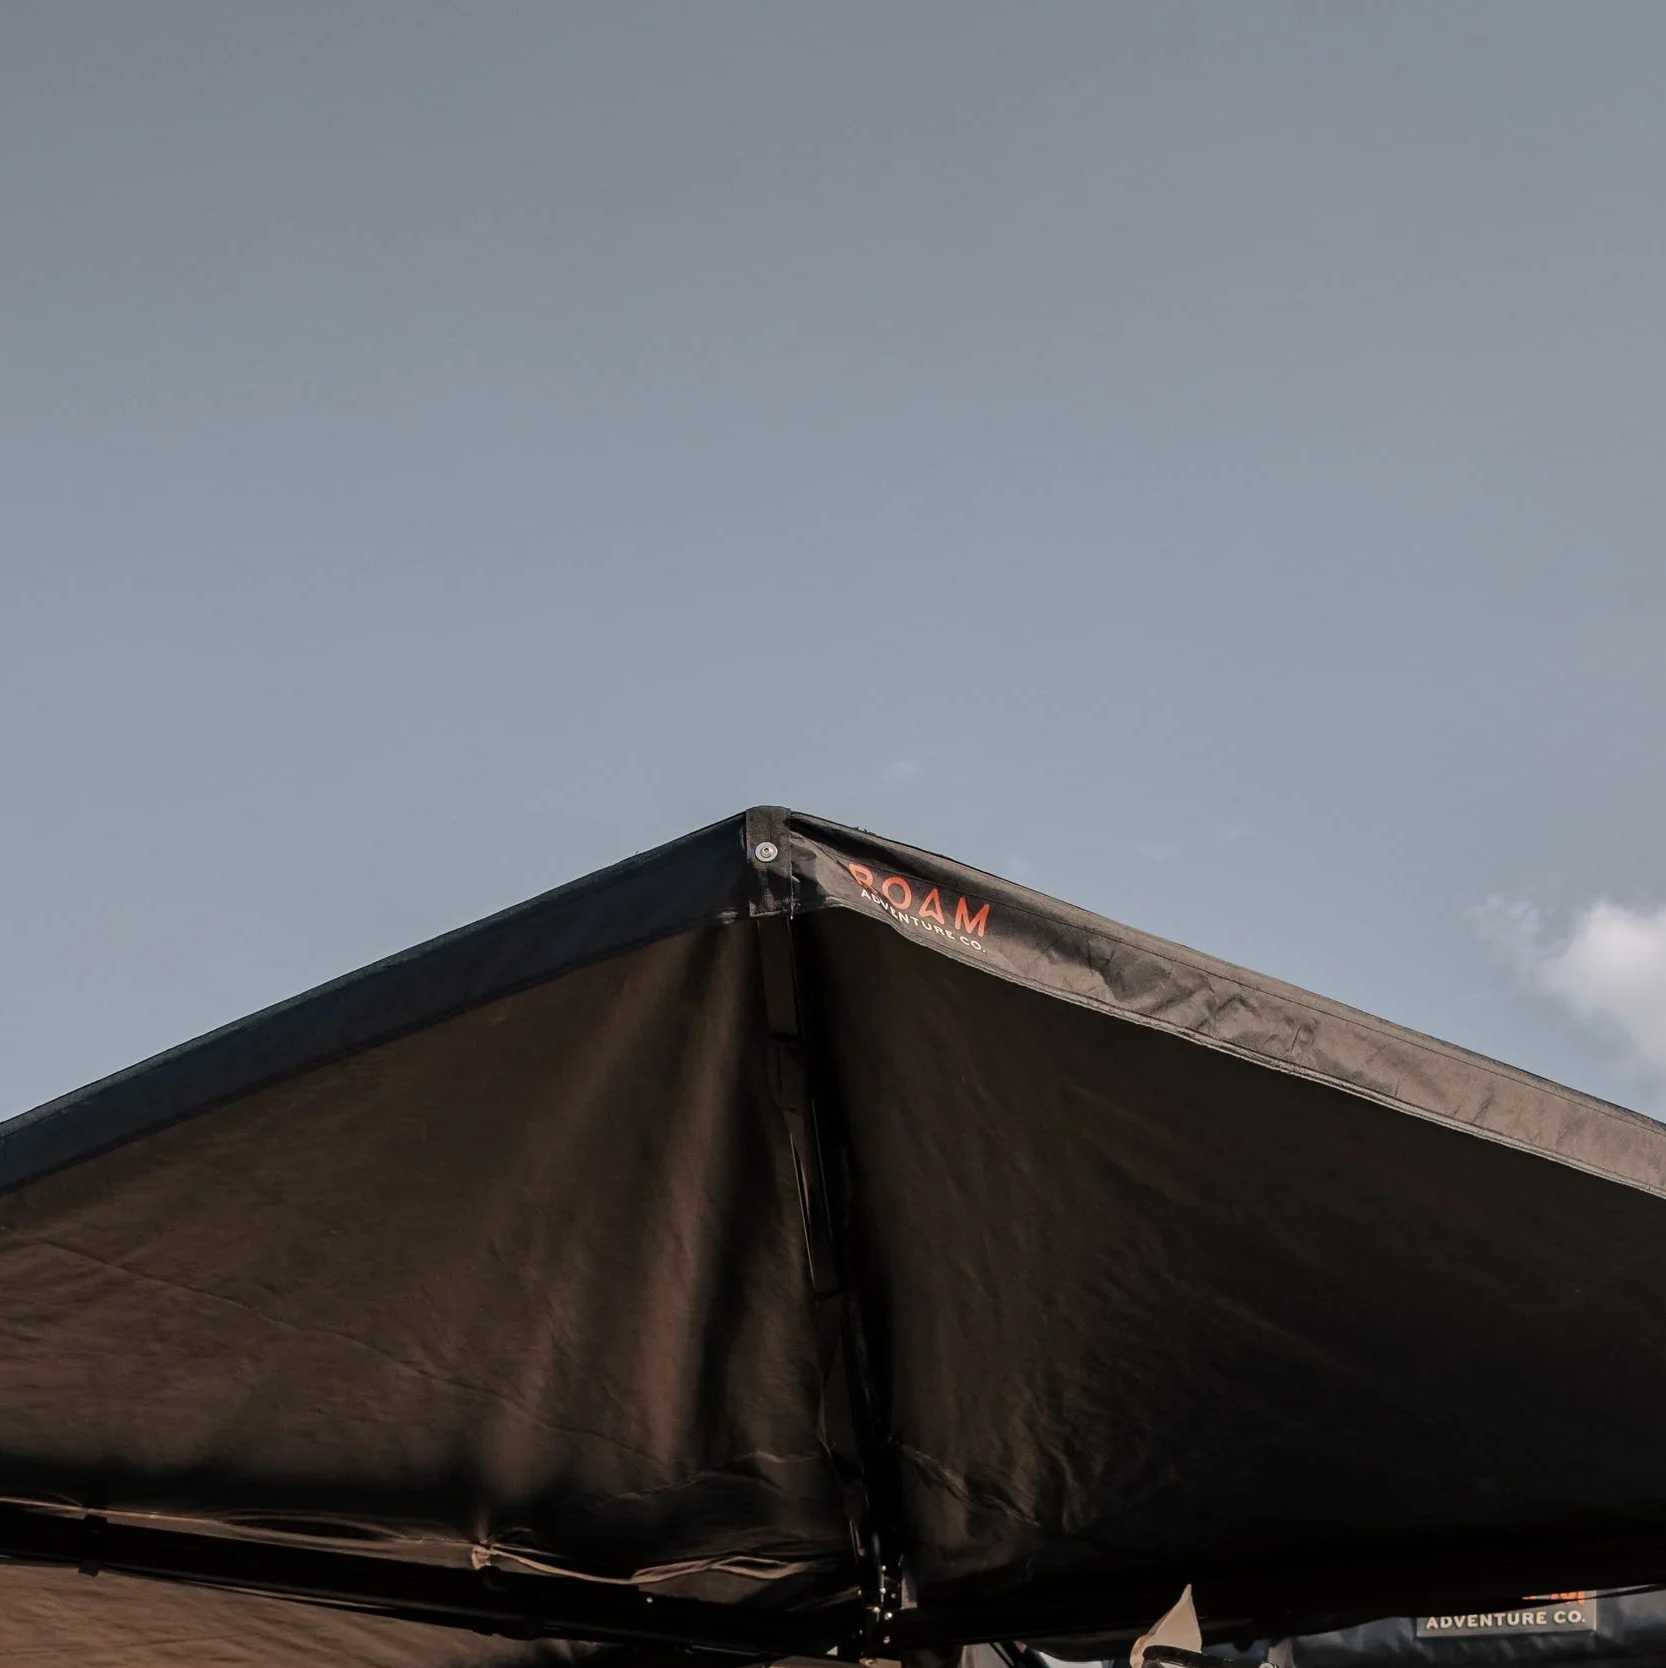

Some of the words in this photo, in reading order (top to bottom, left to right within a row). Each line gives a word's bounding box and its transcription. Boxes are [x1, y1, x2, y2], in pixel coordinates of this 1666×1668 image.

[848, 862, 990, 938] ROAM
[860, 888, 956, 940] ADVENTURE
[959, 935, 987, 953] CO.
[1425, 1611, 1547, 1630] ADVENTURE
[1553, 1609, 1586, 1624] CO.
